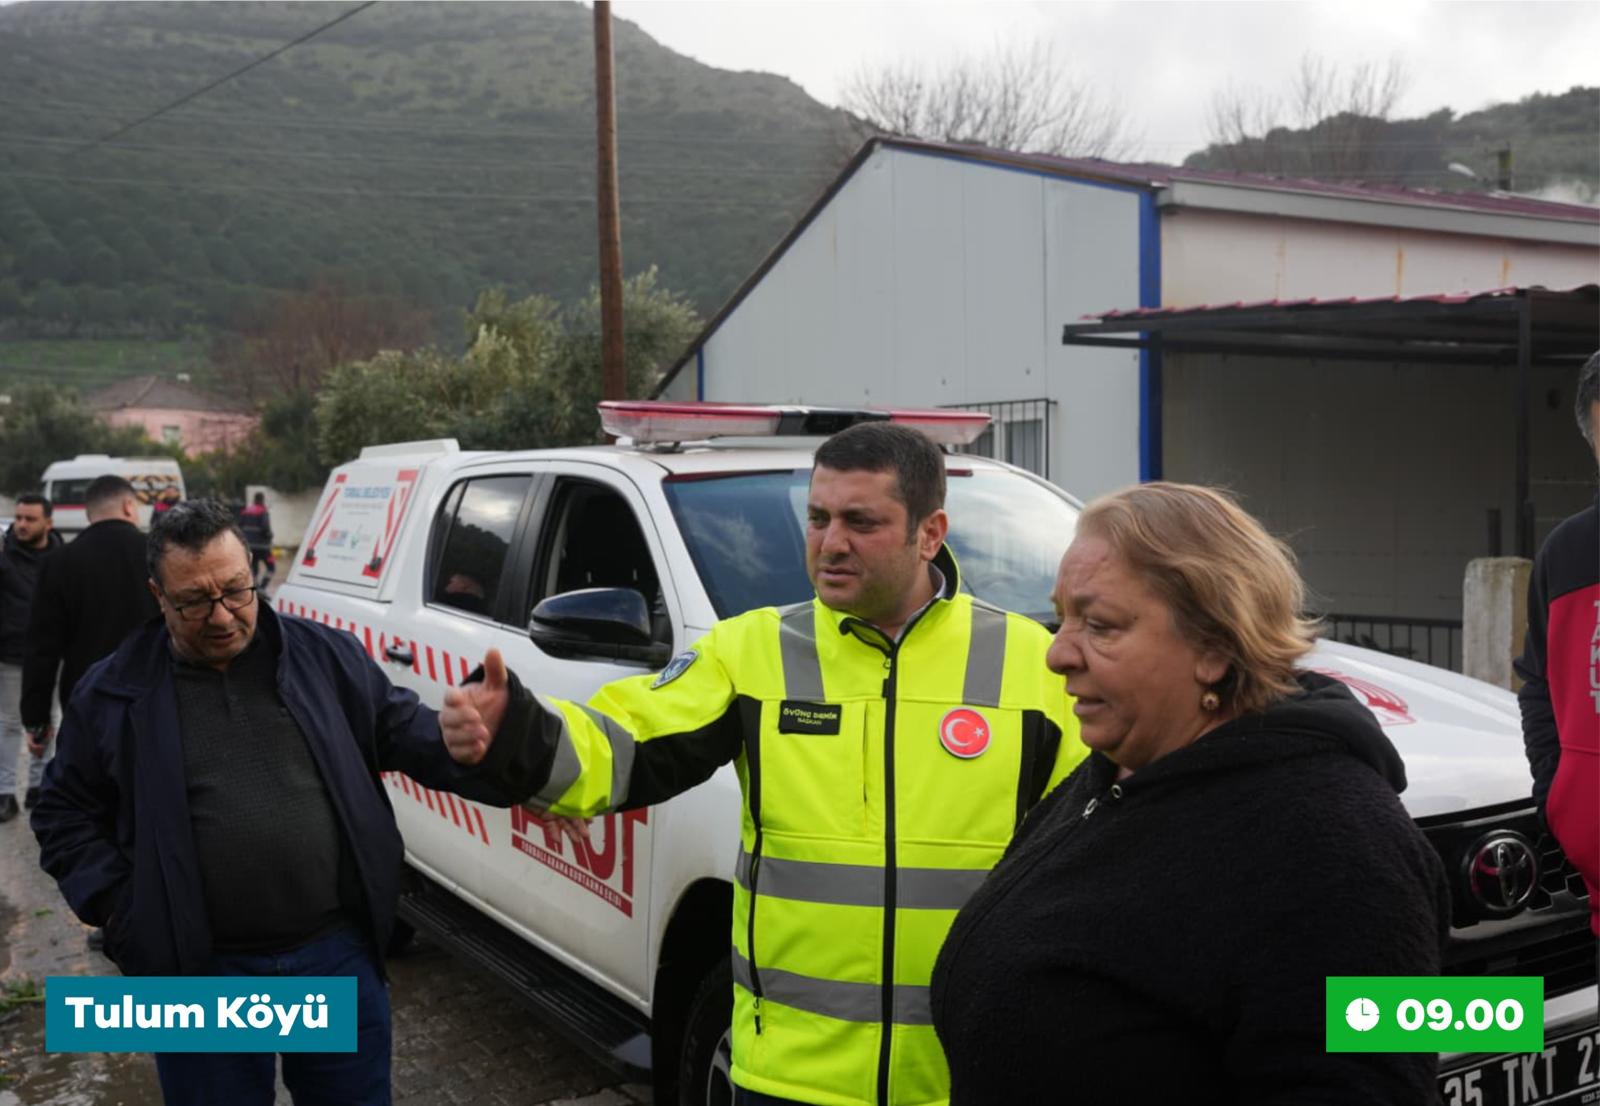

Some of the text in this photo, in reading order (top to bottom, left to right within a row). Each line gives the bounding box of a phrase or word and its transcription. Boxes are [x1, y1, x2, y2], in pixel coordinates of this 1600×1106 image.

[1444, 1033, 1600, 1106] 35 TKT 2
